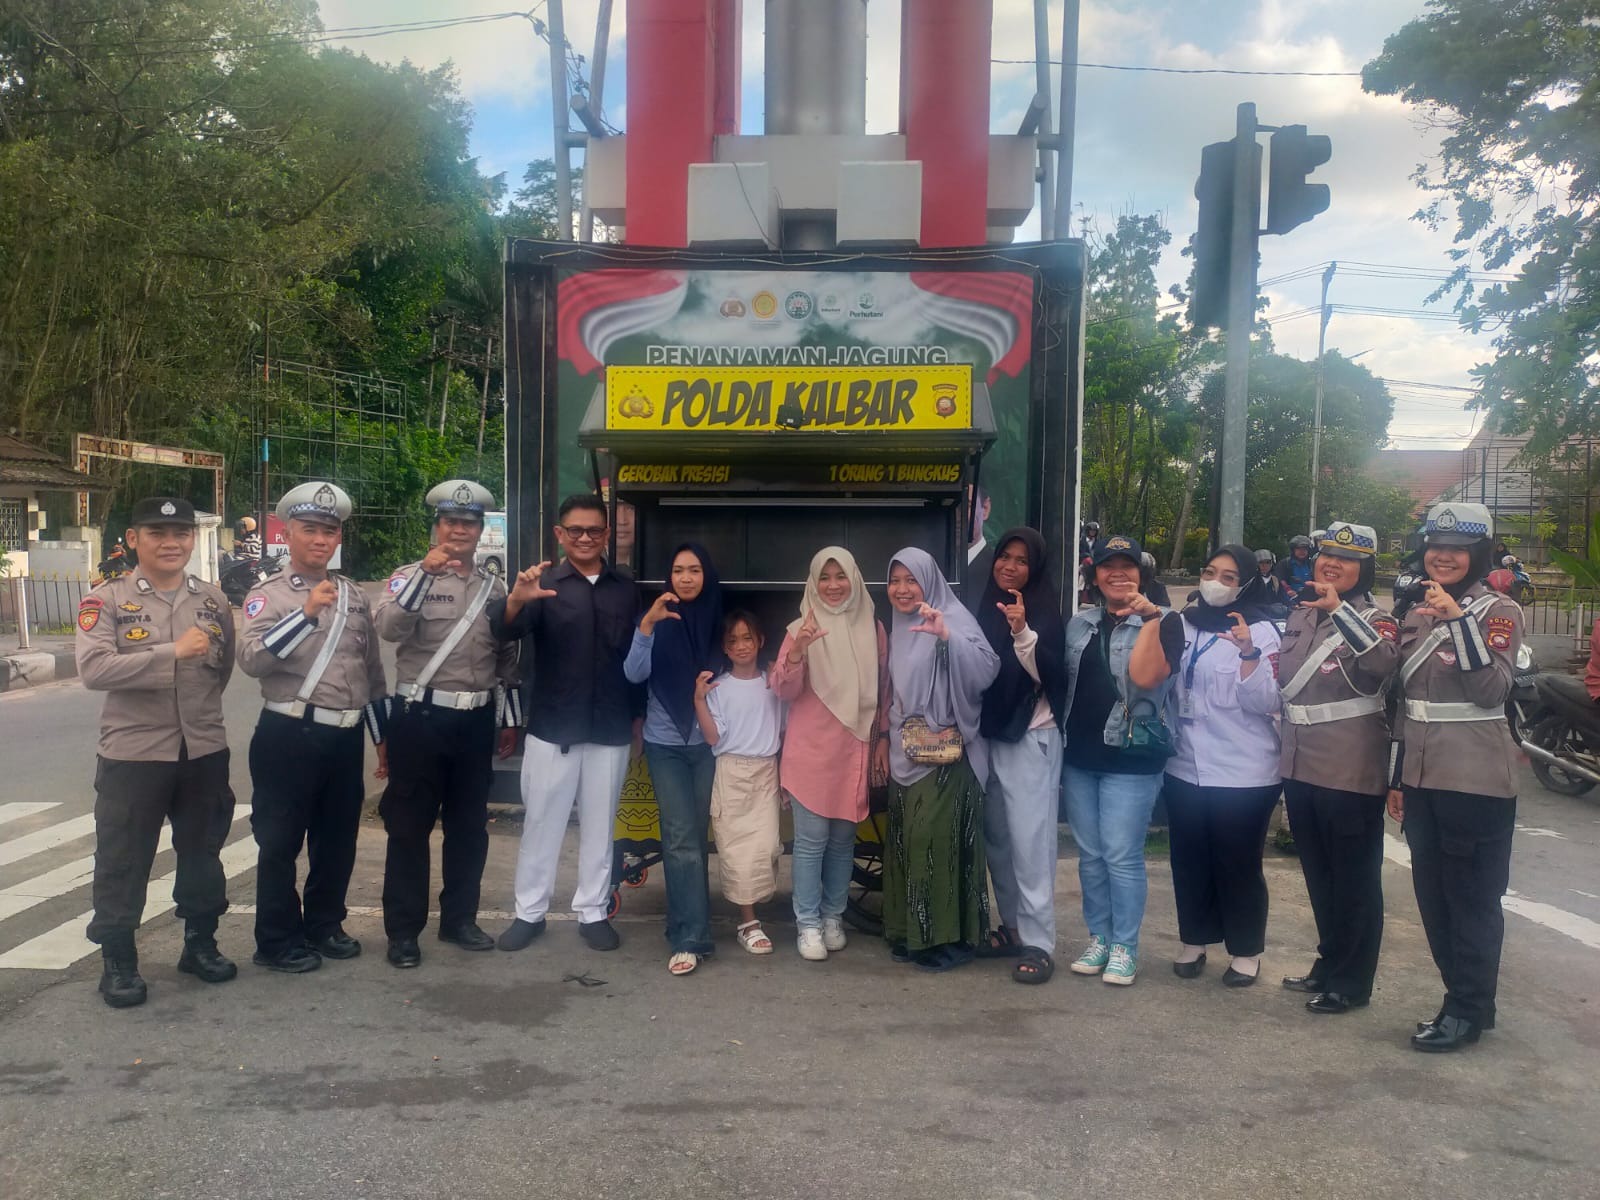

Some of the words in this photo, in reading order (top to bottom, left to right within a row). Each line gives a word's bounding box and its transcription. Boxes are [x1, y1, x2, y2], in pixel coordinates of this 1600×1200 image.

[646, 345, 826, 365] PENANAMAN
[828, 346, 948, 365] JAGUNG
[661, 378, 774, 428] POLDA
[783, 379, 919, 428] KALBAR
[617, 464, 679, 483] GEROBAK
[679, 464, 731, 483] PRESISI
[829, 465, 837, 481] 1
[838, 464, 886, 482] ORANG
[887, 465, 895, 480] 1
[896, 464, 961, 483] BUNGKUS
